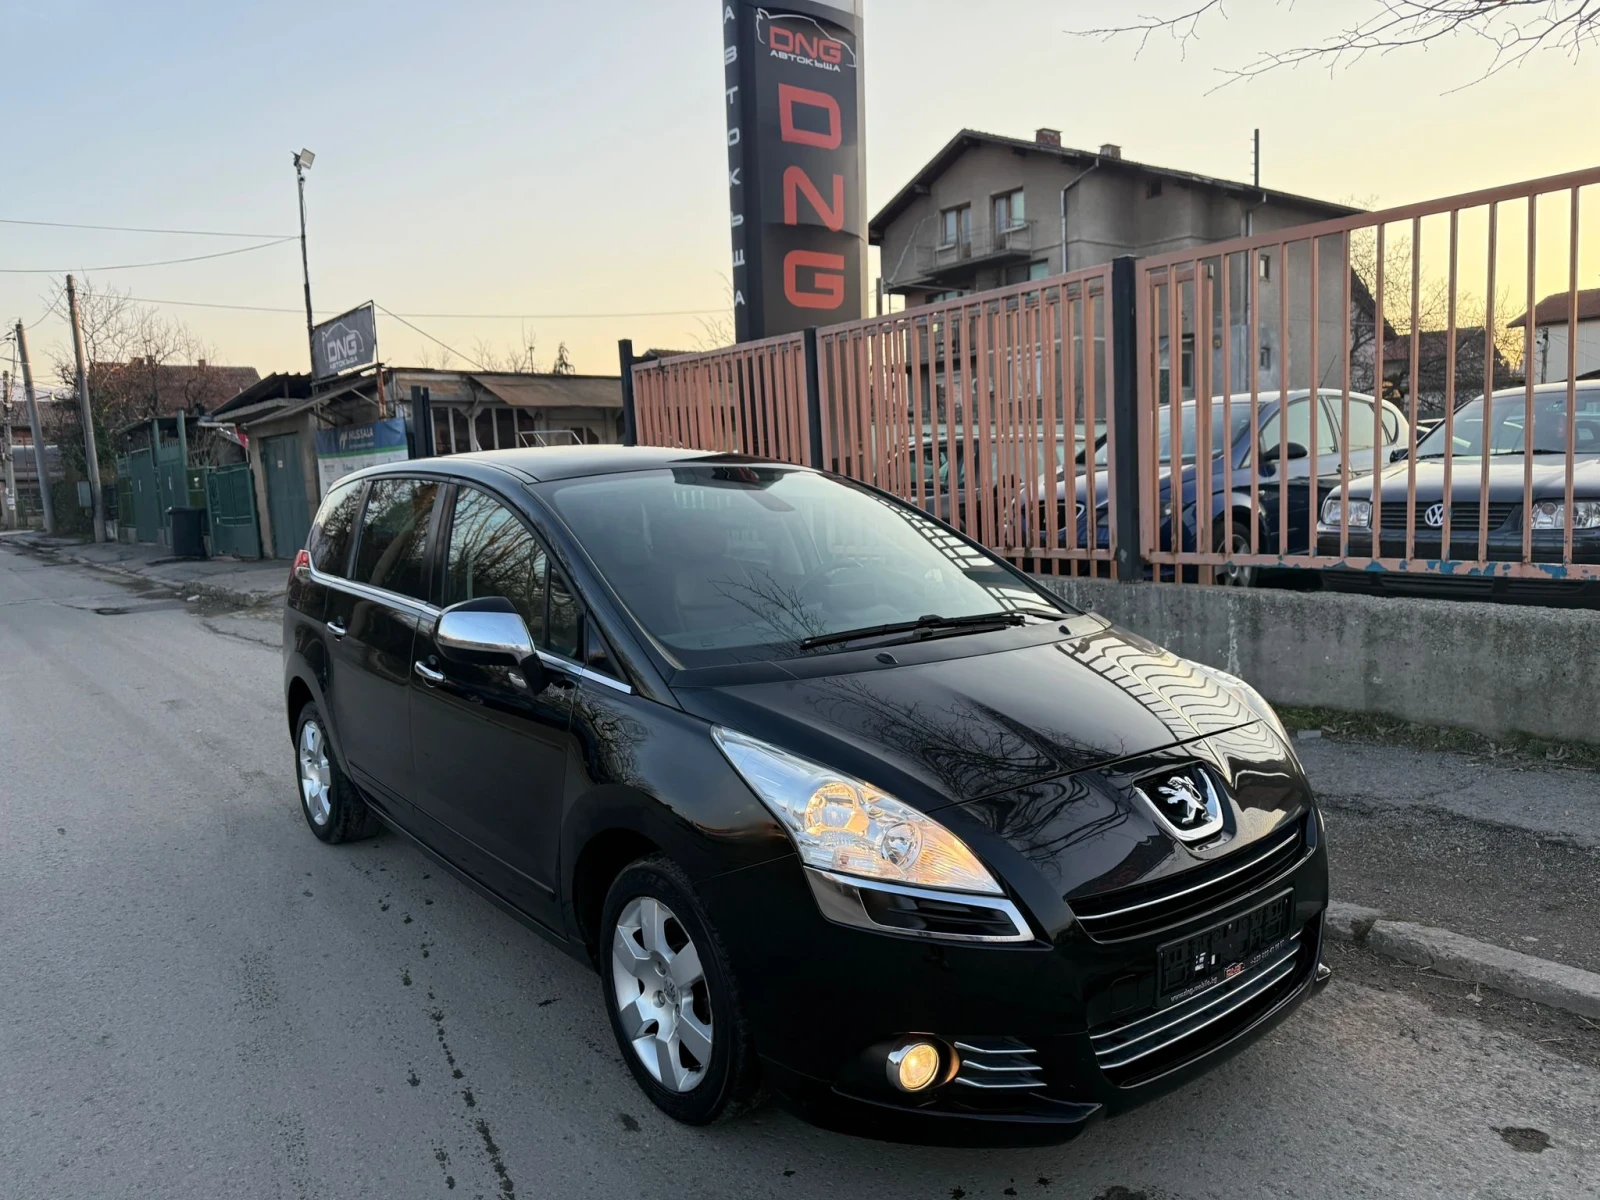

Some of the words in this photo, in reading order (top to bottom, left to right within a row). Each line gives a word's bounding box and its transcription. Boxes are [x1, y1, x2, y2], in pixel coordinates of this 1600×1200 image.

[769, 25, 842, 64] DNG
[778, 82, 845, 310] DNG
[327, 333, 358, 363] DNG
